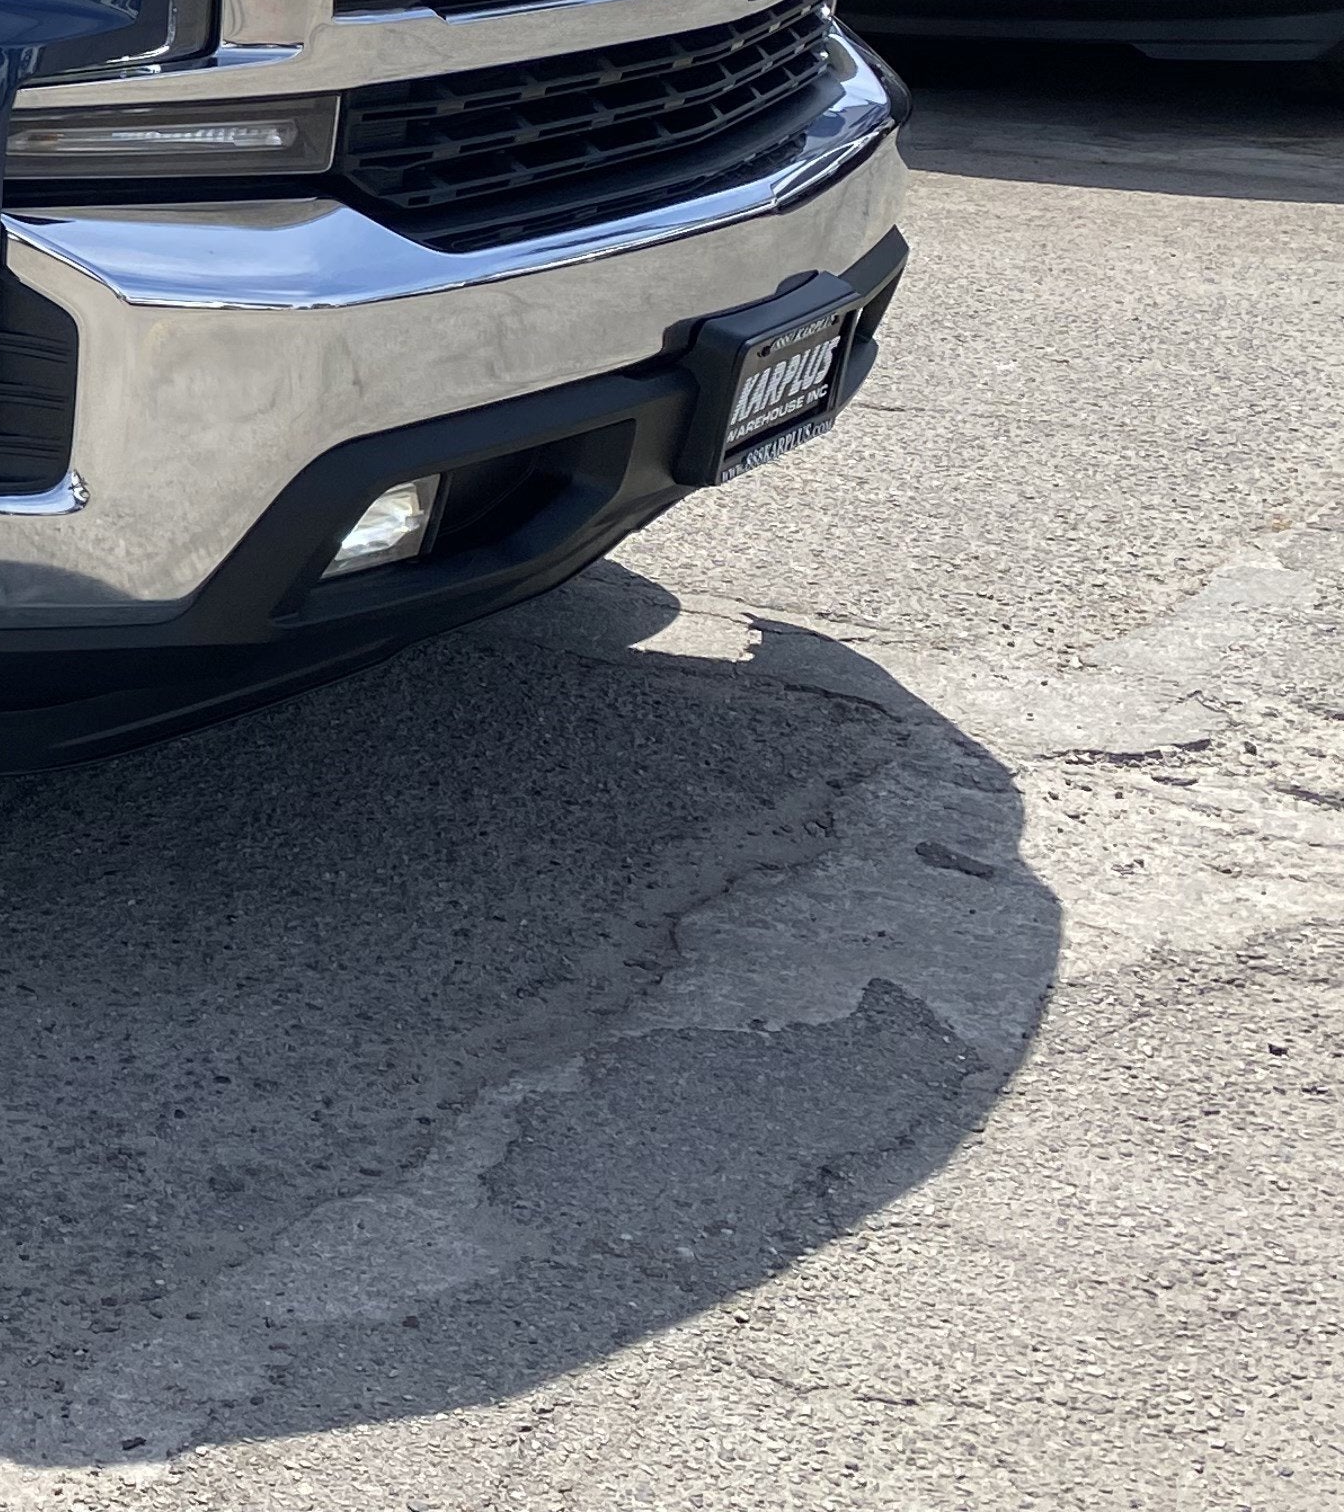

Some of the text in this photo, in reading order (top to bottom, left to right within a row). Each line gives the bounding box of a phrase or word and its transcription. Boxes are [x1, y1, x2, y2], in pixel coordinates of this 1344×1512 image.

[728, 384, 828, 443] WAREHOUSE INC
[730, 336, 841, 426] KARPLUS
